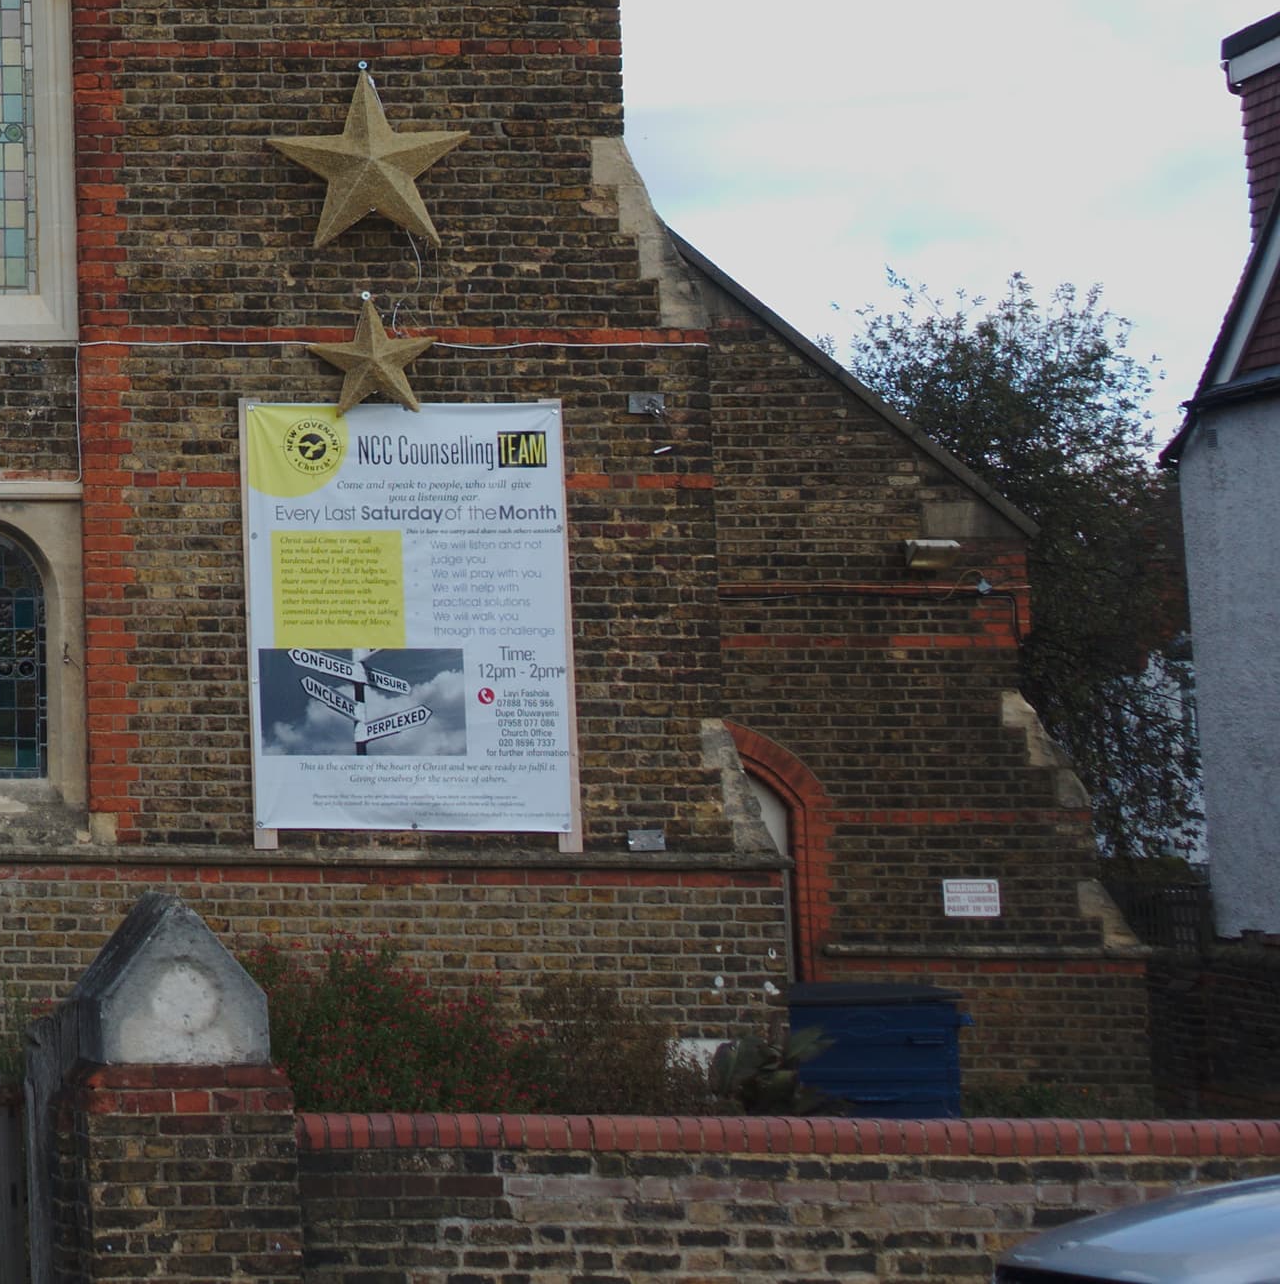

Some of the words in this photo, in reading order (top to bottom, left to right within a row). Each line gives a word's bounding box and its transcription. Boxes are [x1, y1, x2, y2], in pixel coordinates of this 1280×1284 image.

[287, 429, 297, 452] NEW
[297, 422, 339, 452] COVENANT
[358, 434, 393, 466] NCC
[398, 434, 494, 471] Counselling
[498, 432, 547, 466] TEAM
[298, 461, 330, 471] Church
[336, 480, 364, 490] Come
[366, 480, 385, 490] and
[387, 480, 415, 493] speak
[417, 482, 426, 490] to
[428, 480, 463, 493] people,
[465, 480, 486, 490] who
[488, 480, 506, 490] will
[510, 480, 531, 493] give
[388, 494, 406, 505] you
[417, 492, 458, 504] listening
[461, 494, 480, 502] ear.
[276, 505, 319, 524] Every
[325, 505, 356, 520] Last
[361, 505, 443, 524] Saturday
[445, 505, 462, 520] of
[468, 505, 496, 520] the
[499, 505, 557, 520] Month
[430, 540, 448, 550] We
[450, 540, 466, 550] will
[468, 540, 496, 550] listen
[498, 540, 521, 550] and
[524, 540, 542, 550] not
[430, 555, 463, 566] judge
[465, 556, 486, 566] you
[432, 569, 448, 578] We
[451, 569, 467, 578] will
[470, 570, 494, 579] pray
[497, 569, 517, 578] with
[521, 570, 542, 579] you
[432, 583, 448, 592] We
[452, 583, 467, 592] will
[470, 582, 494, 594] help
[498, 583, 519, 592] with
[432, 597, 481, 608] practical
[484, 597, 531, 607] solutions
[433, 611, 450, 621] We
[454, 611, 469, 621] will
[471, 611, 496, 621] walk
[499, 613, 519, 622] you
[434, 626, 476, 638] through
[479, 626, 497, 636] this
[499, 626, 555, 638] challenge
[498, 646, 536, 661] Time:
[292, 649, 353, 676] CONFUSED
[478, 663, 516, 682] 12pm
[529, 663, 560, 682] 2pm
[306, 678, 356, 716] UNCLEAR
[367, 708, 426, 736] PERPLEXED
[501, 728, 528, 737] Church
[530, 728, 553, 737] Office
[498, 738, 513, 747] 020
[486, 749, 498, 757] for
[499, 749, 524, 757] further
[526, 749, 569, 757] information
[300, 762, 316, 771] This
[318, 762, 324, 771] is
[326, 762, 338, 771] the
[340, 762, 364, 771] centre
[366, 762, 374, 773] of
[376, 762, 389, 771] the
[390, 762, 411, 771] heart
[412, 762, 421, 773] of
[422, 762, 447, 771] Christ
[449, 762, 465, 771] and
[495, 762, 516, 773] ready
[350, 774, 376, 785] Giving
[377, 774, 413, 783] ourselves
[414, 774, 427, 785] for
[428, 774, 440, 783] the
[443, 774, 468, 783] service
[471, 774, 479, 785] of
